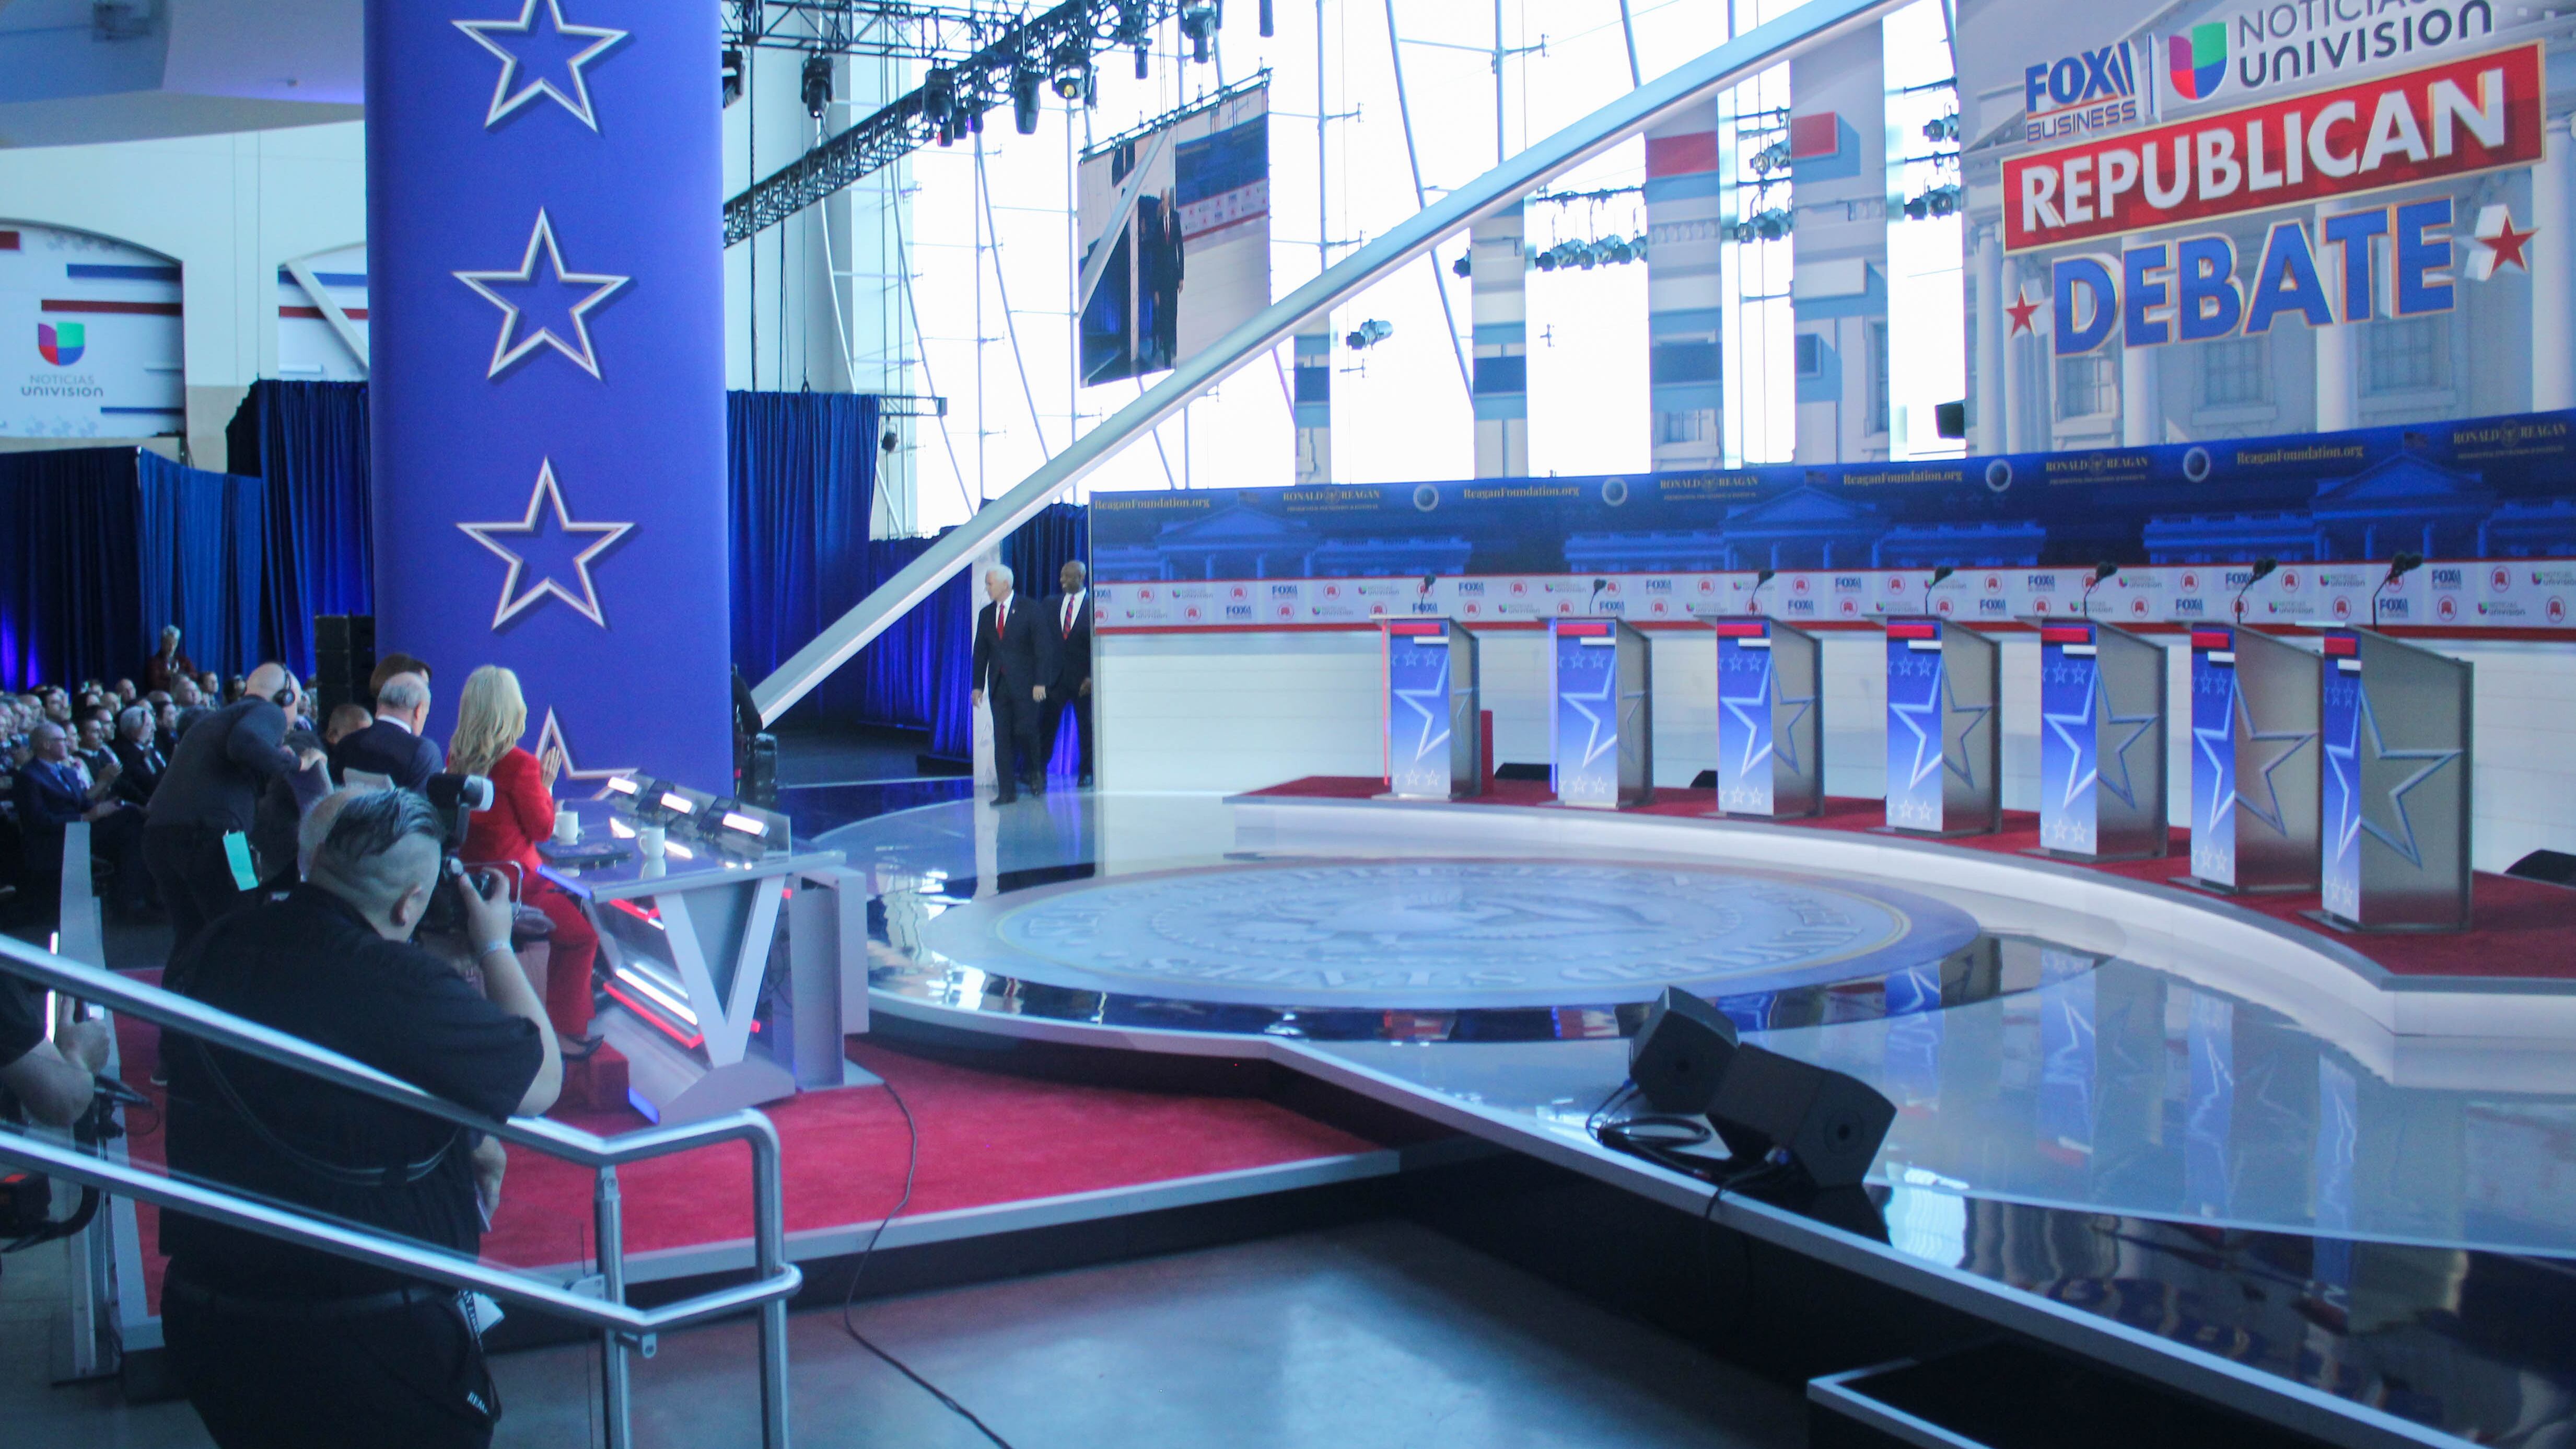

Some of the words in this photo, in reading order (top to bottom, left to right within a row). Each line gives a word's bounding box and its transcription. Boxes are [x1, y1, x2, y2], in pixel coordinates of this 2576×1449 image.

[2239, 0, 2428, 48] NOTICI
[2239, 0, 2492, 88] UNIVISION
[2025, 42, 2129, 116] FOX
[2027, 100, 2137, 143] BUSINESS
[2020, 68, 2505, 233] REPUBLICAN
[2052, 196, 2457, 357] DEBATE
[30, 374, 94, 385] NOTICIAS
[21, 386, 104, 397] UNIVISION
[2028, 575, 2055, 586] FOX
[2432, 569, 2461, 583] FOX
[1459, 582, 1484, 592] FOX
[1646, 579, 1671, 589] FOX
[1835, 577, 1861, 588] FOX
[1272, 585, 1297, 595] FOX
[1600, 601, 1625, 611] FOX
[1788, 600, 1814, 610] FOX
[1980, 599, 2006, 610] FOX
[2176, 599, 2202, 610] FOX
[2380, 598, 2408, 611] FOX
[1226, 606, 1251, 616] FOX
